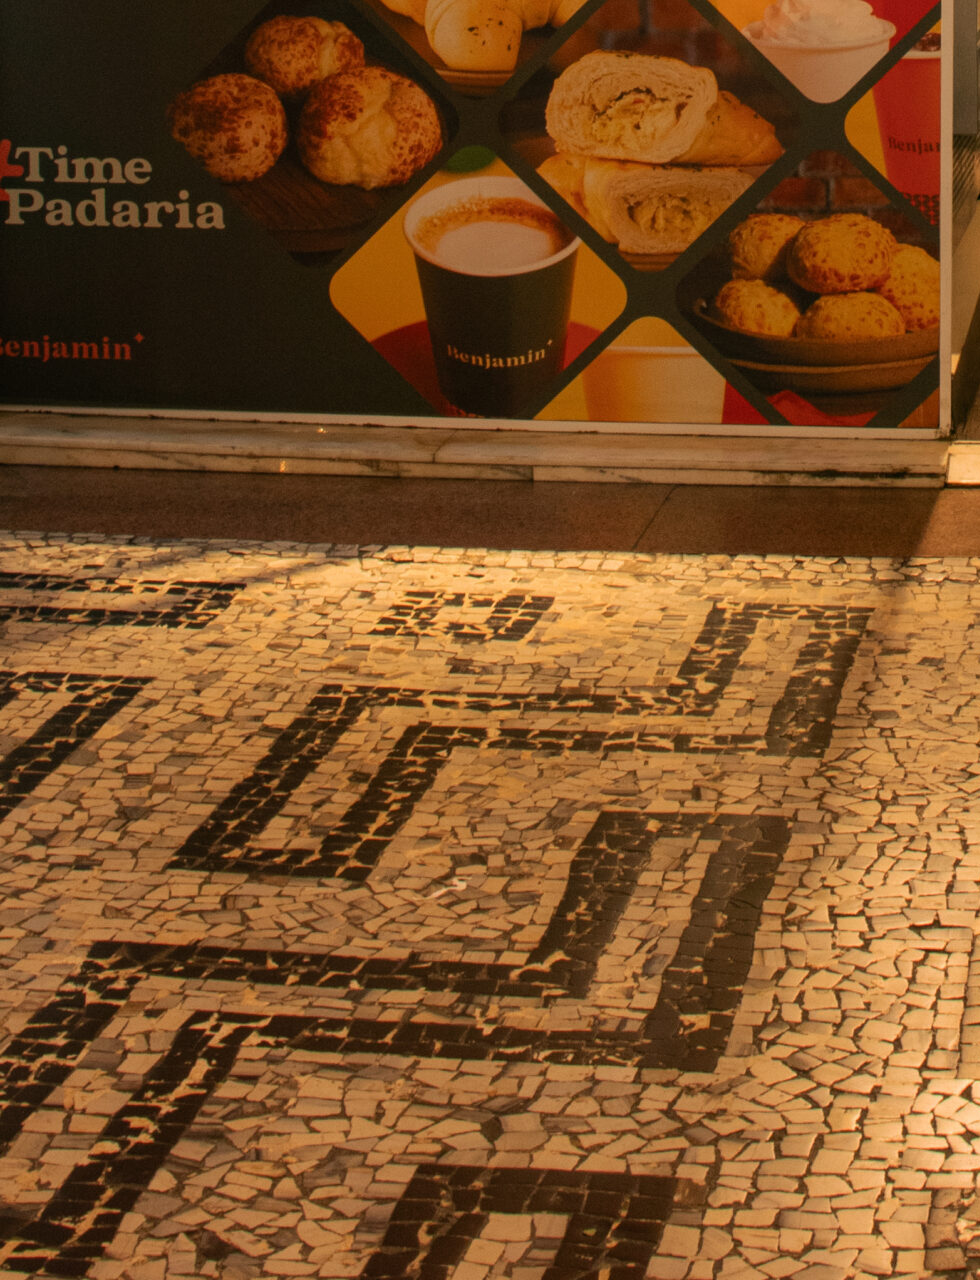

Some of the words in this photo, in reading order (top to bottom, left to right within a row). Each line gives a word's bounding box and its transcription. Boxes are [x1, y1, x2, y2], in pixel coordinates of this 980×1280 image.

[15, 145, 152, 184] Time
[4, 188, 225, 229] Padaria
[0, 335, 131, 362] enjamin
[447, 344, 546, 369] Benjamin
